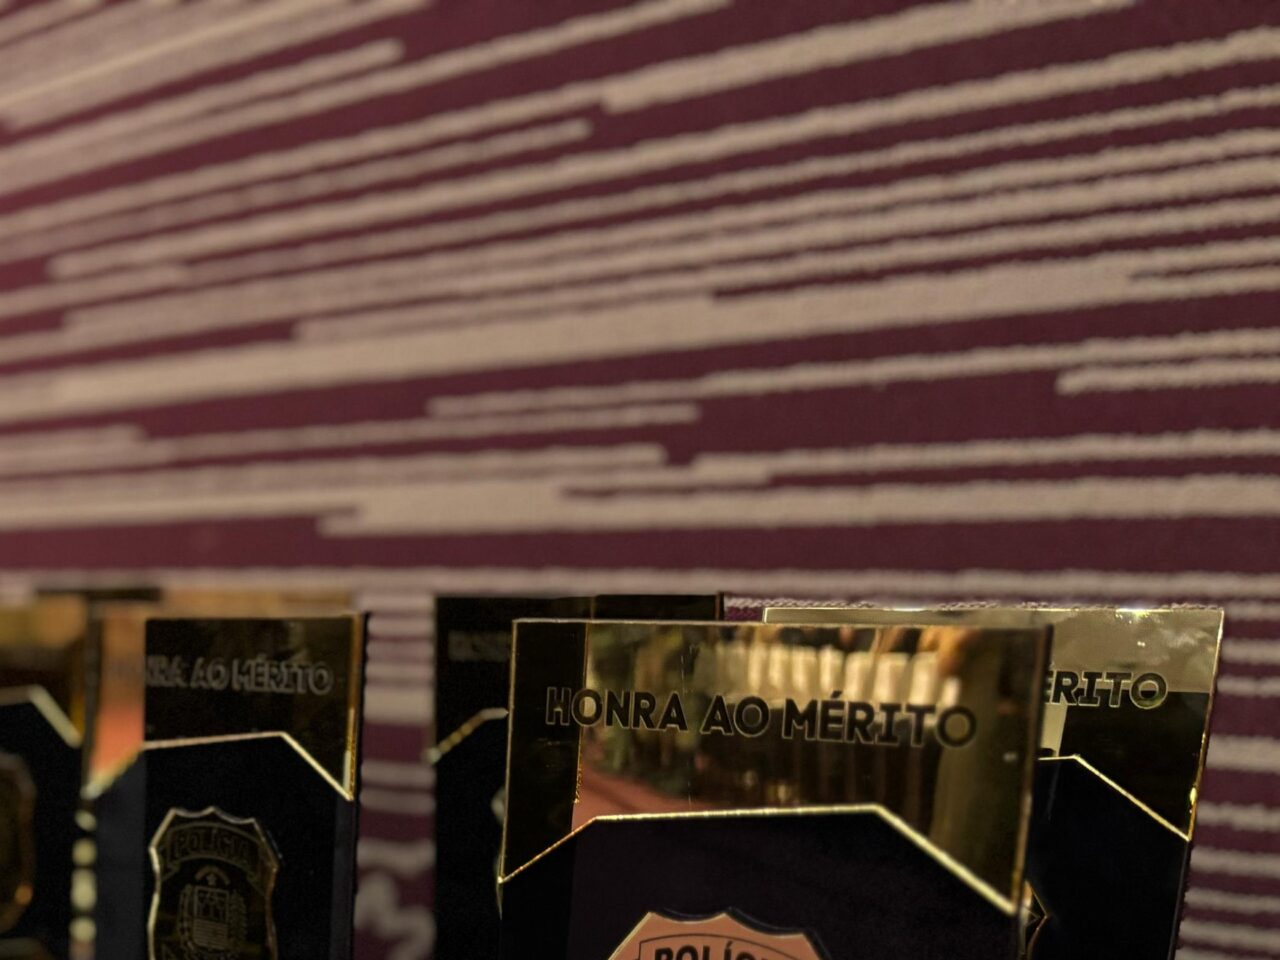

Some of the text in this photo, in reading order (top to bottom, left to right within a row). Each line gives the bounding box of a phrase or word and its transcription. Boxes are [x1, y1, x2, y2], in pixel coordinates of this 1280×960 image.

[232, 653, 335, 696] MÉRITO
[545, 686, 978, 749] HONRA AO MÉRITO
